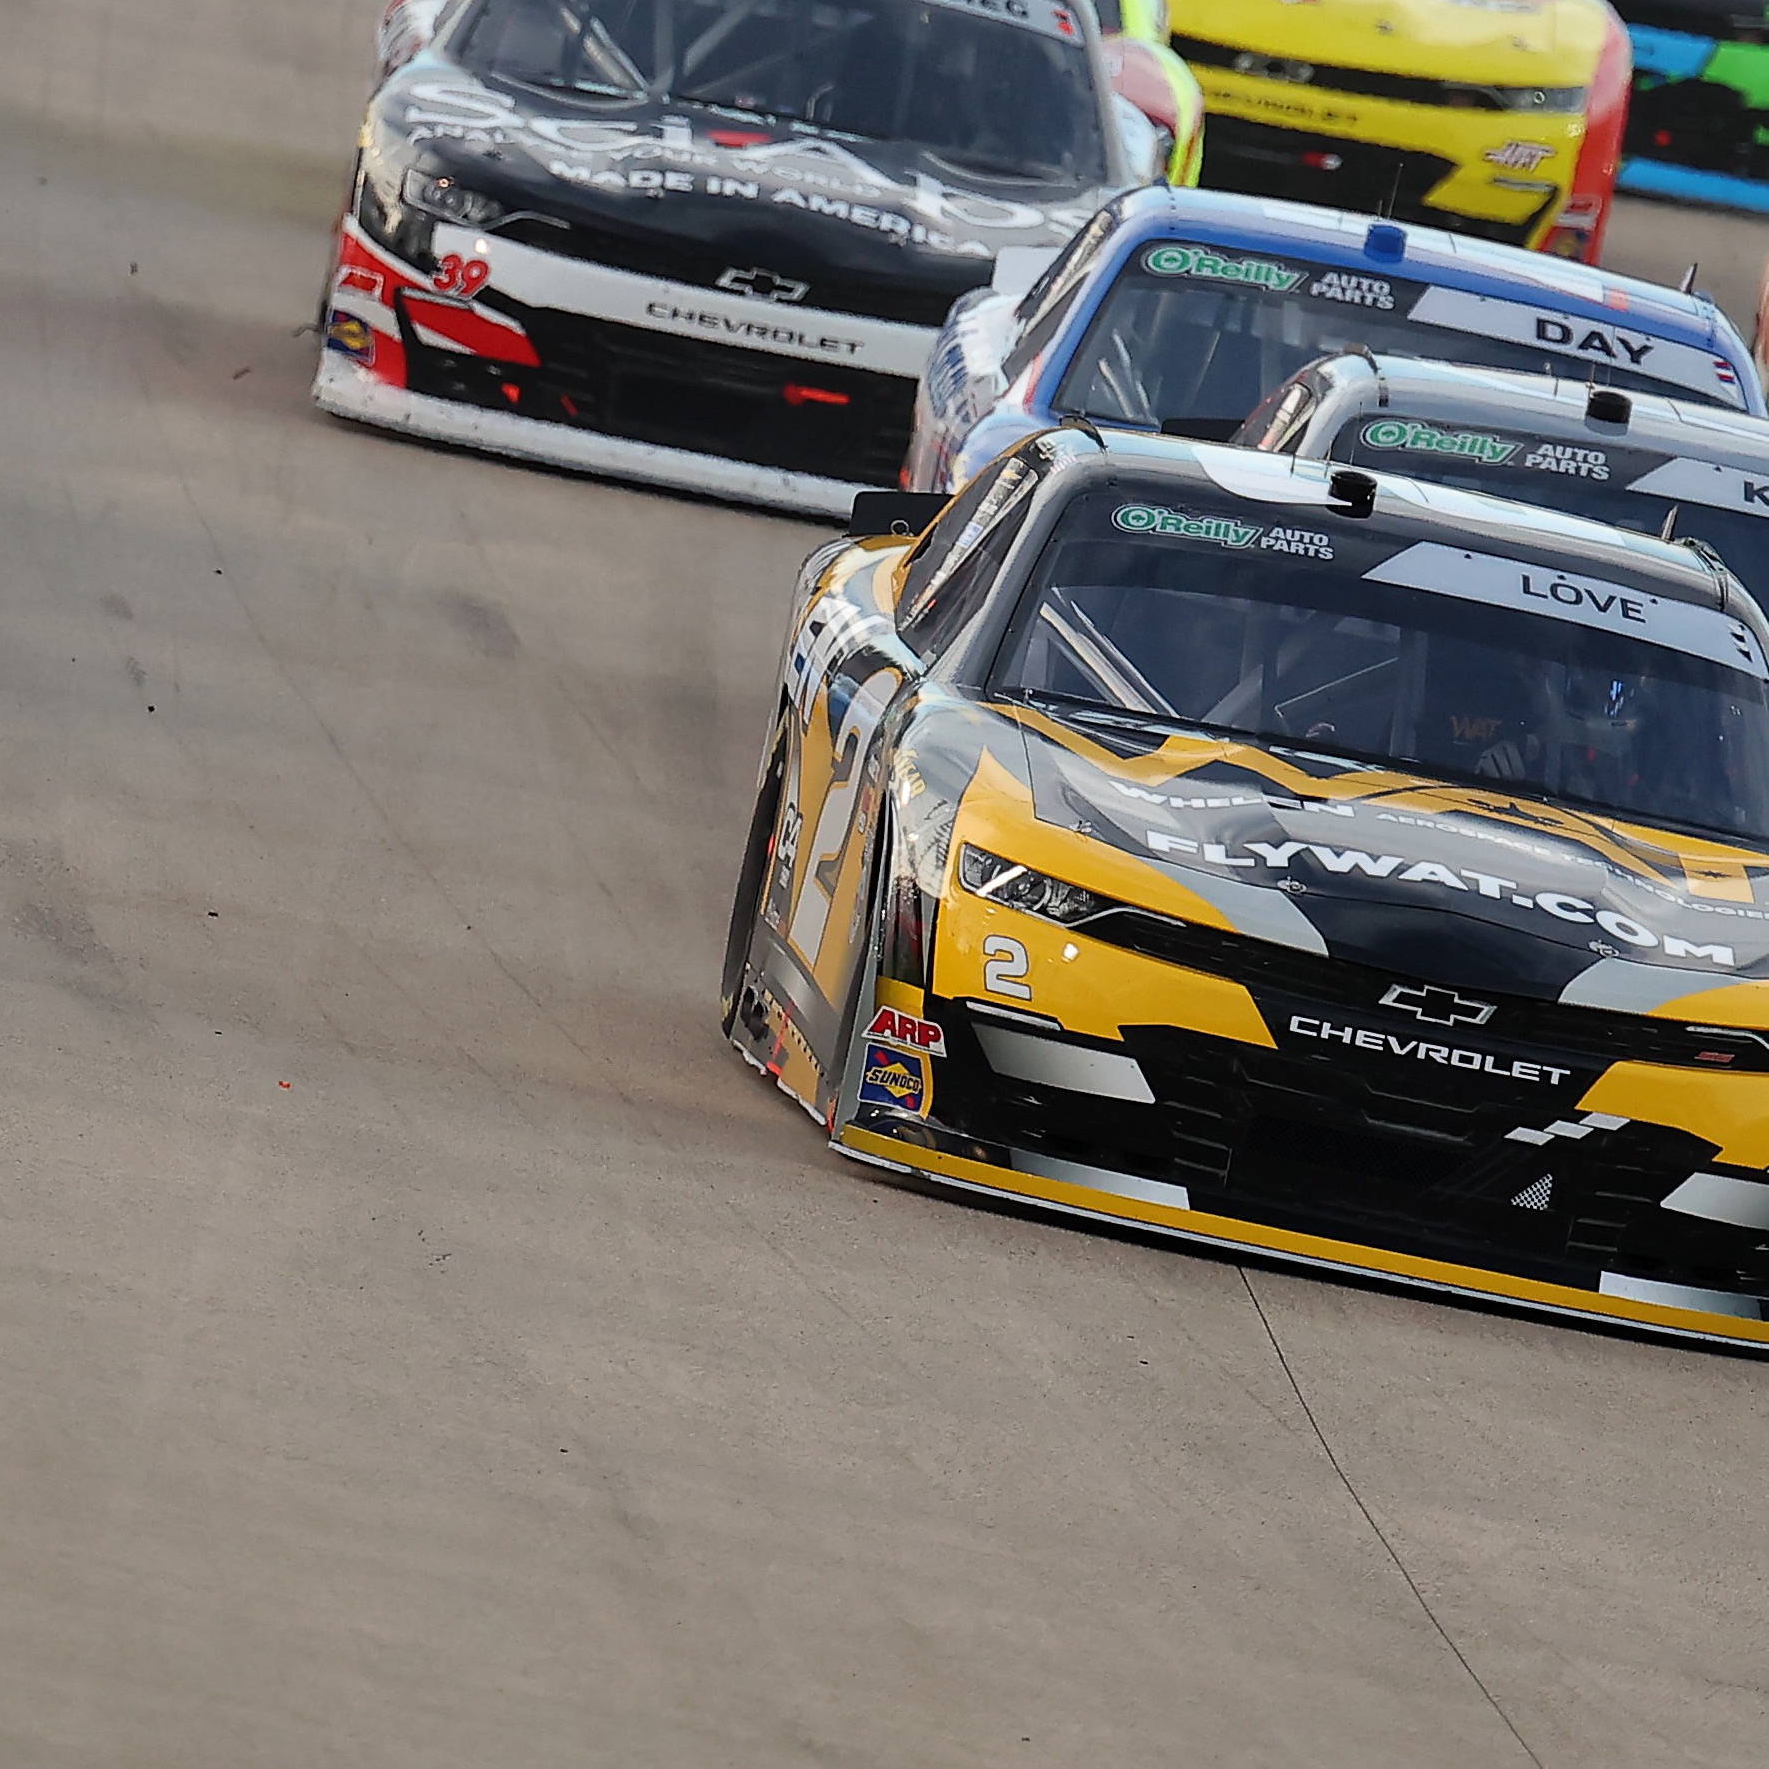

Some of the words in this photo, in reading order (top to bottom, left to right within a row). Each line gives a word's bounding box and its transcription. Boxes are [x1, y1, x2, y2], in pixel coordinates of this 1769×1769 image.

[548, 159, 694, 194] MADE
[705, 175, 760, 200] IN
[770, 188, 993, 259] AMERICA
[433, 251, 491, 300] 39
[1147, 246, 1302, 291] O'Reilly
[1321, 271, 1392, 294] AUTO
[1309, 282, 1396, 311] PARTS
[645, 300, 866, 356] CHEVROLET
[1534, 315, 1655, 367] DAY
[1363, 419, 1521, 465] O'Reilly
[1535, 442, 1608, 466] AUTO
[1524, 454, 1612, 482] PARTS
[1114, 505, 1257, 546] O'Reilly
[1268, 527, 1330, 546] AUTO
[1260, 536, 1335, 561] PARTS
[1521, 573, 1647, 625] LOVE
[1107, 780, 1357, 819] WHELEN
[1376, 812, 1551, 857] AEROSPACE
[1145, 829, 1736, 967] FLYWAT.COM
[982, 934, 1033, 1003] 2
[868, 1009, 943, 1049] ARP
[1288, 1014, 1572, 1086] CHEVROLET
[869, 1069, 922, 1093] SUNOCO
